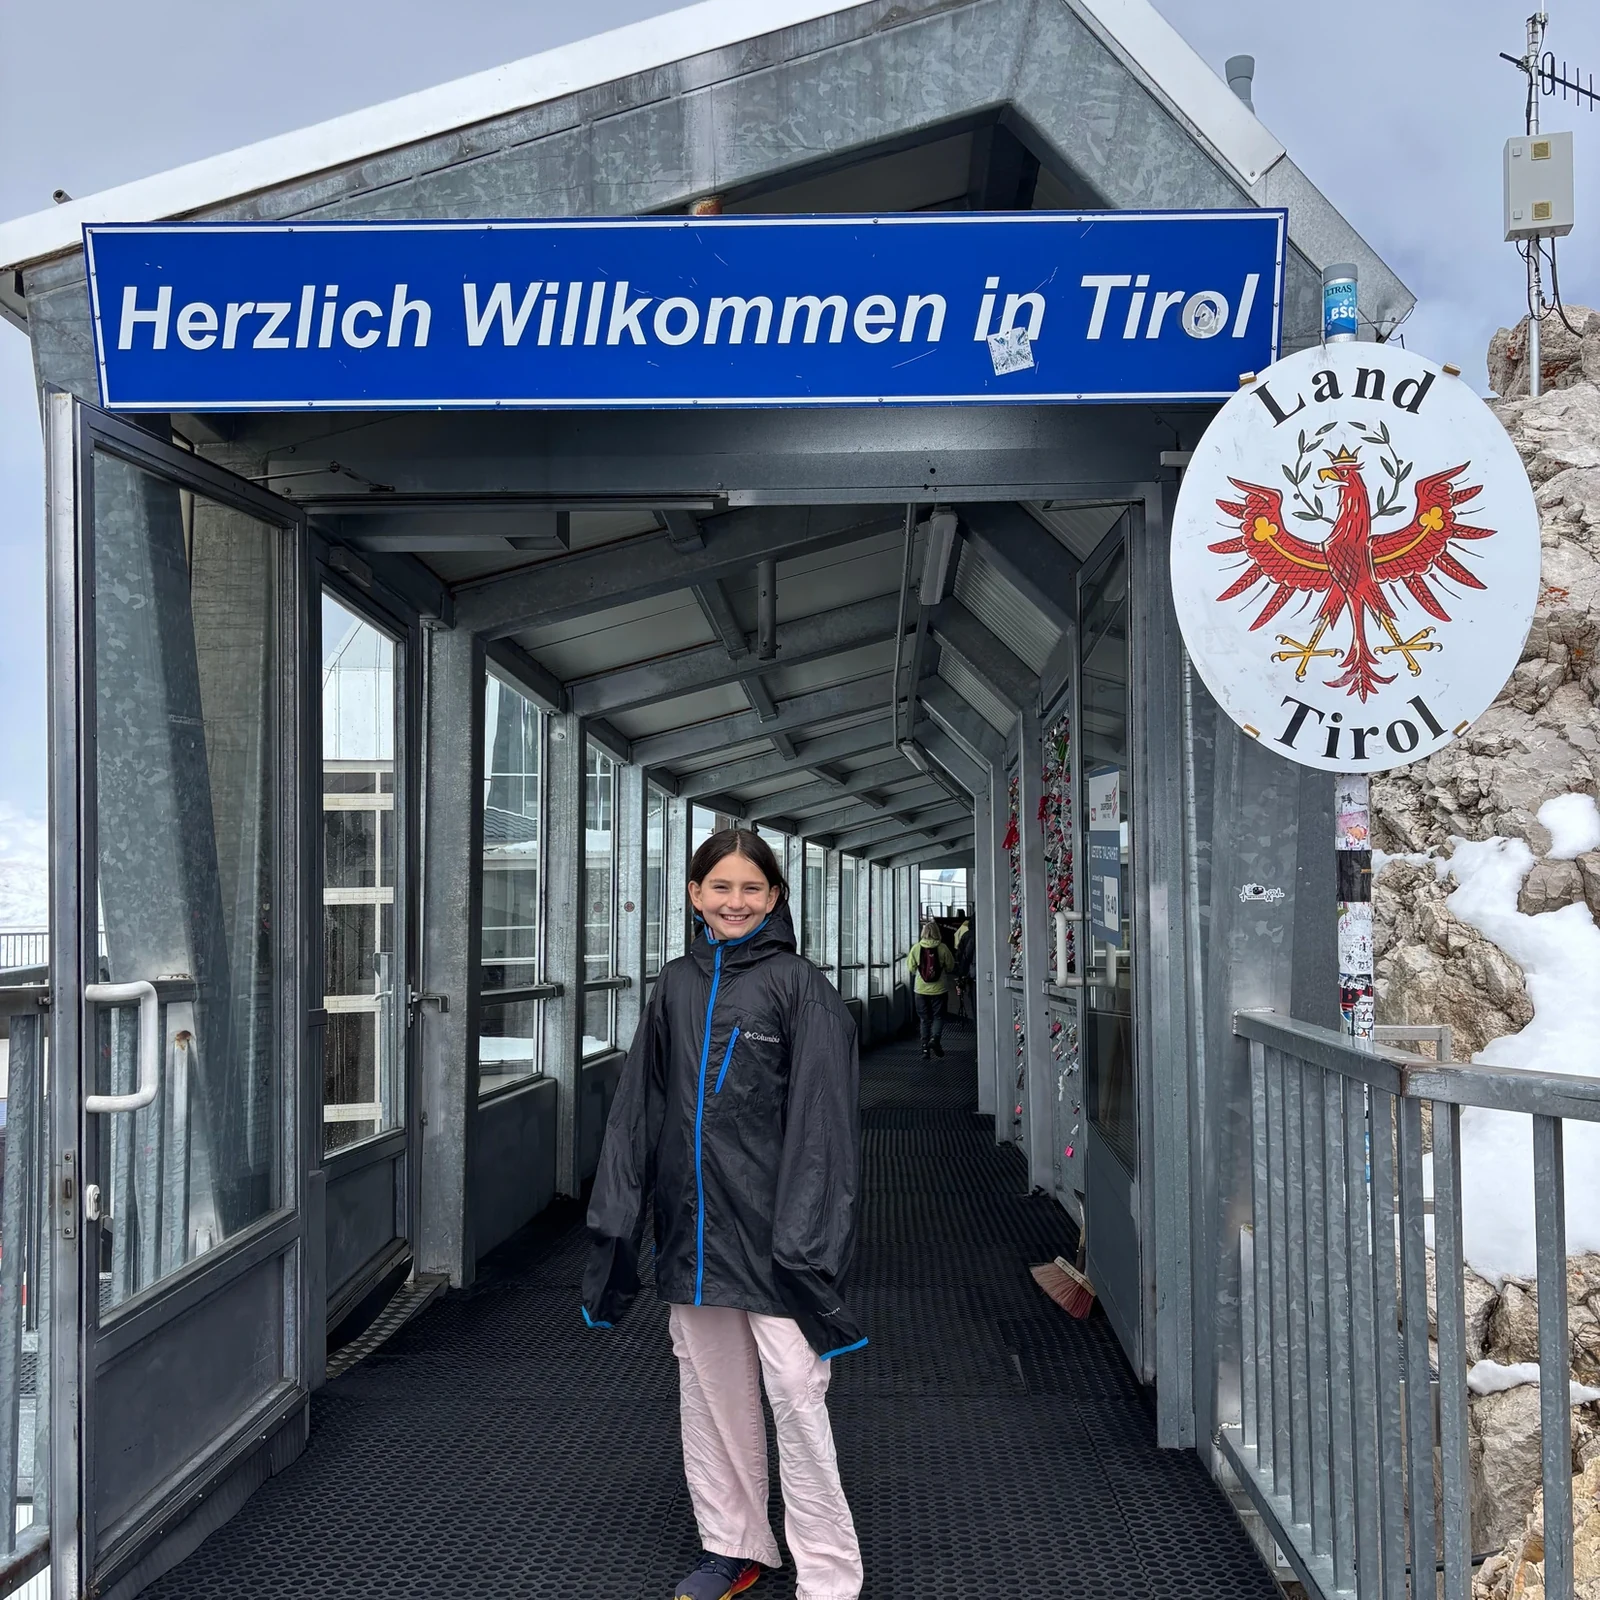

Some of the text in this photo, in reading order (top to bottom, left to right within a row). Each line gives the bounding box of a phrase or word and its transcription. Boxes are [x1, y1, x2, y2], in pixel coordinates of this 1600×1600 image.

[117, 272, 1260, 350] Herzlich Willkommen in Tirol
[1249, 366, 1436, 429] Land
[1272, 695, 1449, 762] Tirol
[751, 1032, 780, 1044] Columbia
